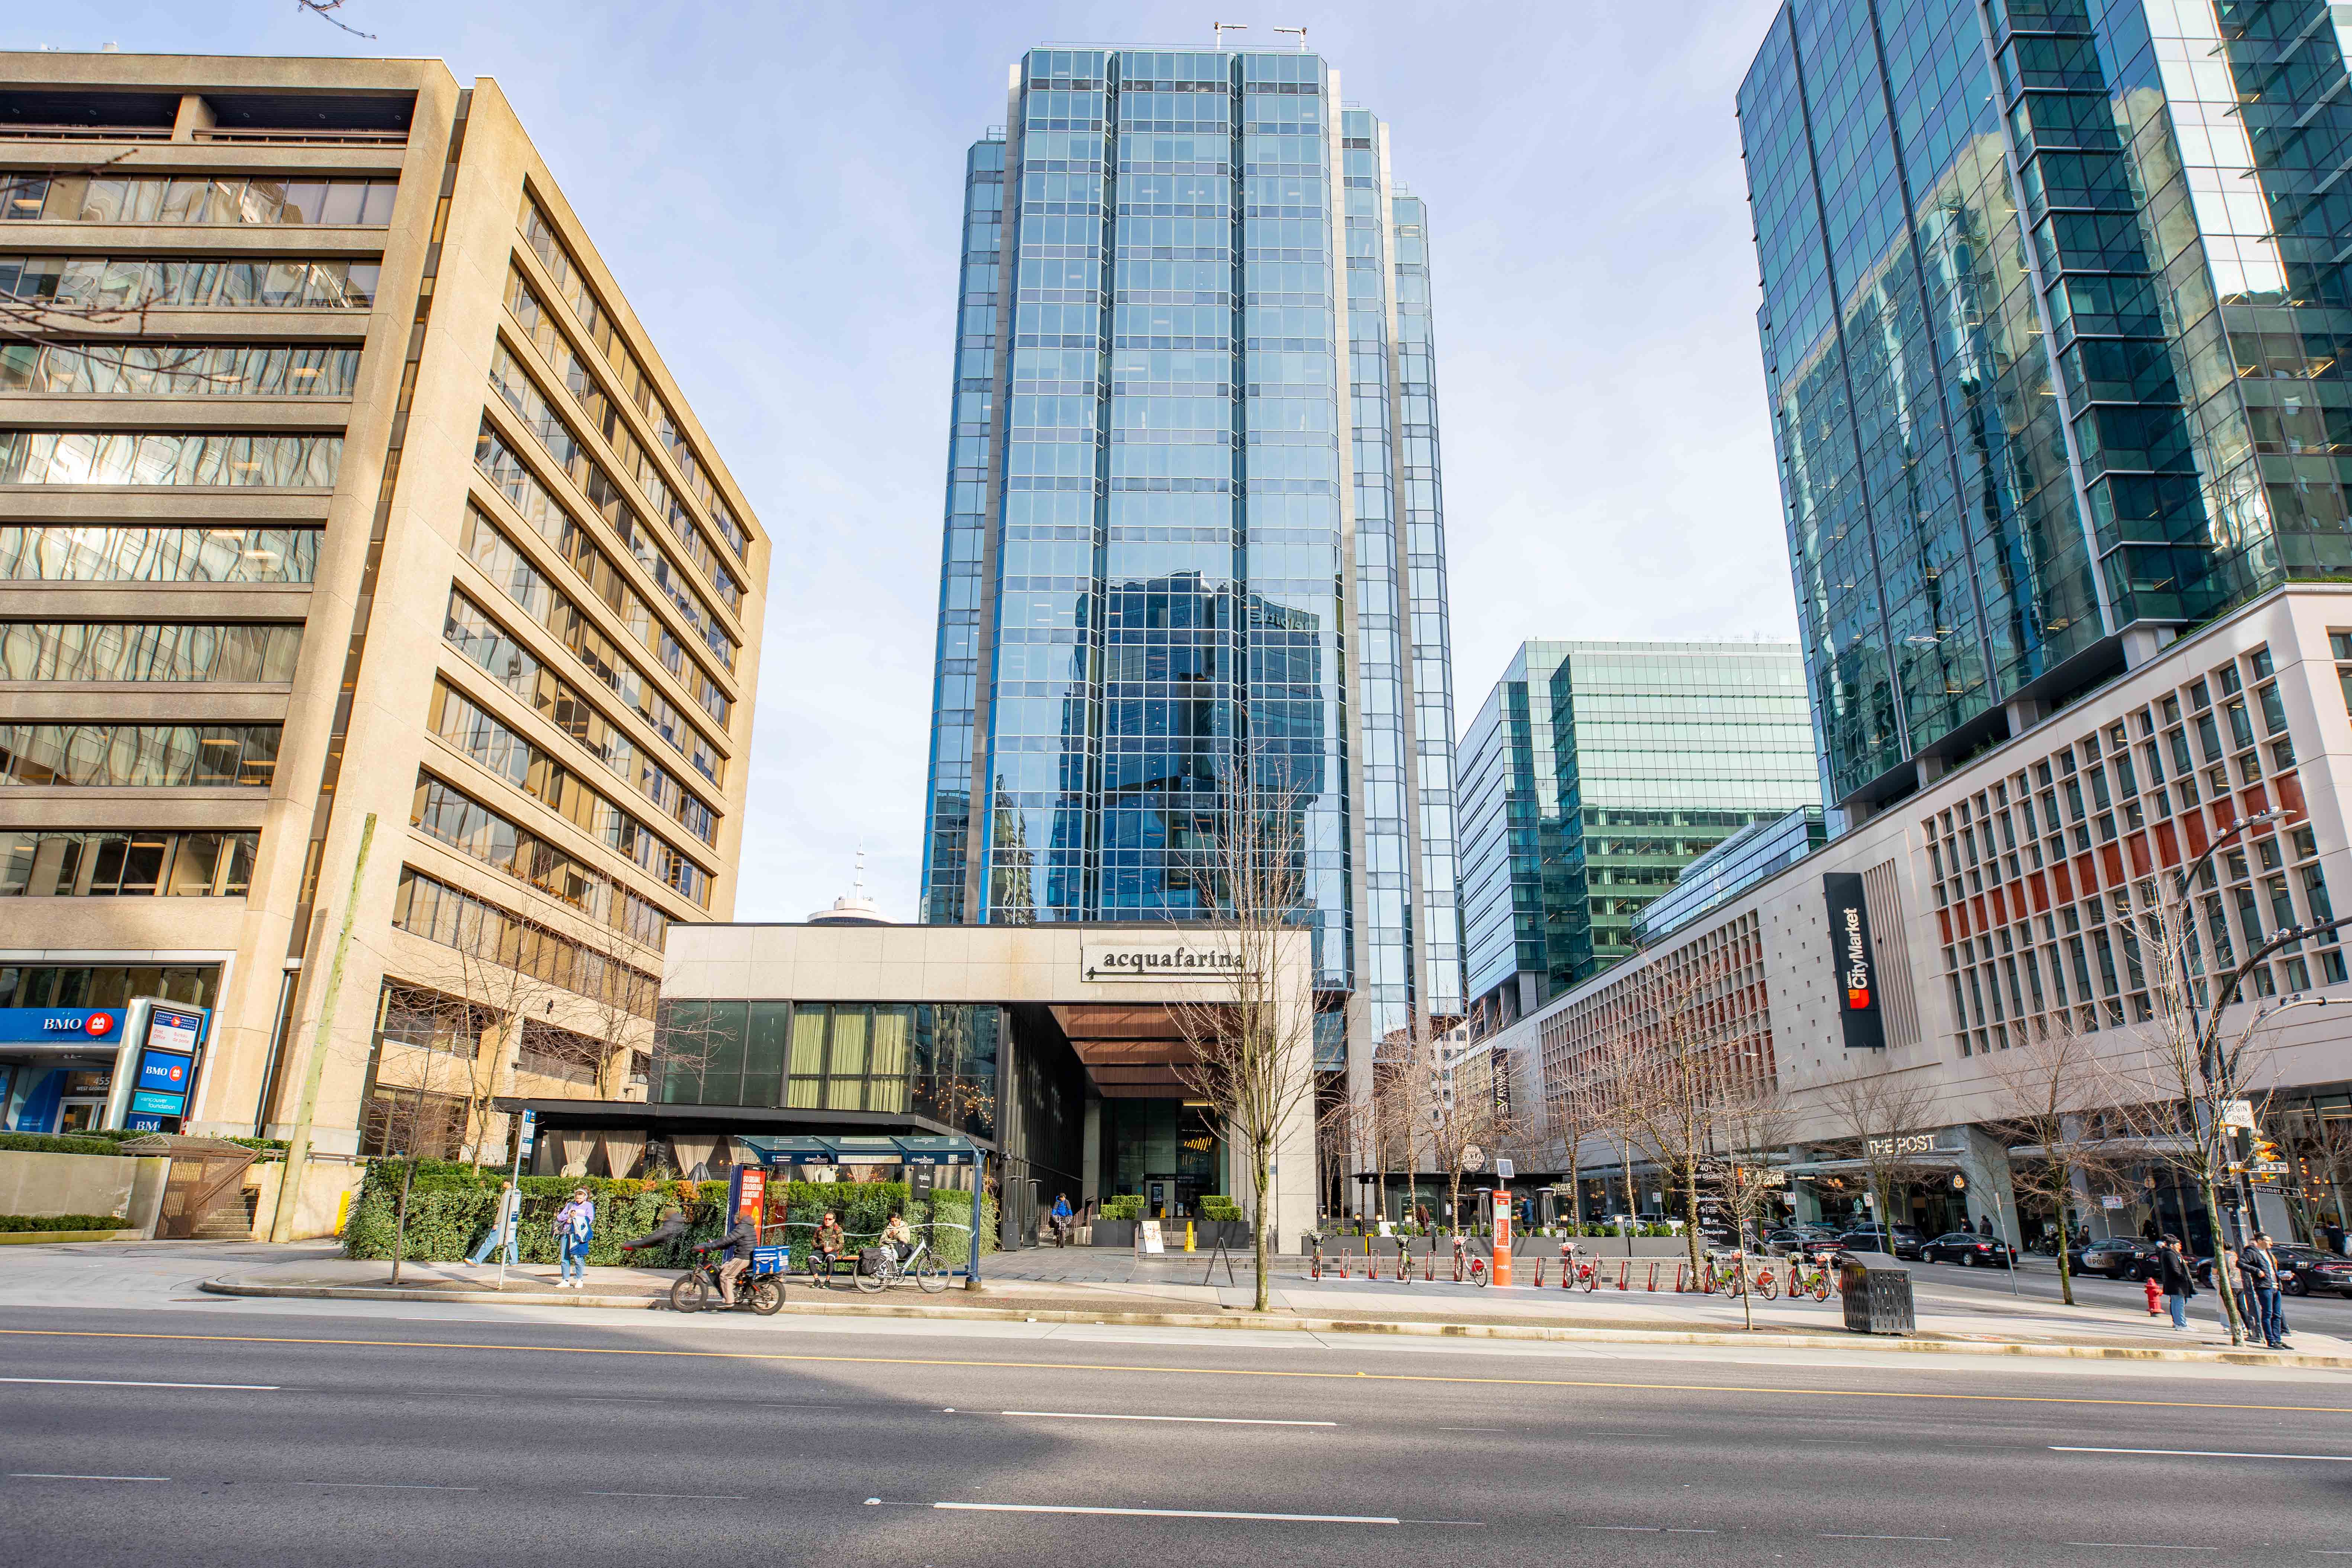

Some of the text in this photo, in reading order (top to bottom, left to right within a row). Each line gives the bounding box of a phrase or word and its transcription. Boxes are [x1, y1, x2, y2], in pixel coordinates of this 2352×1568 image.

[1843, 908, 1869, 989] CityMarket
[1103, 947, 1244, 973] acquafarina
[43, 1018, 82, 1029] BMO
[145, 1066, 168, 1076] BMO
[136, 1121, 160, 1131] BM
[1868, 1134, 1935, 1154] THE POST
[1557, 1183, 1571, 1192] EVOLVE
[2257, 1186, 2281, 1194] Homer
